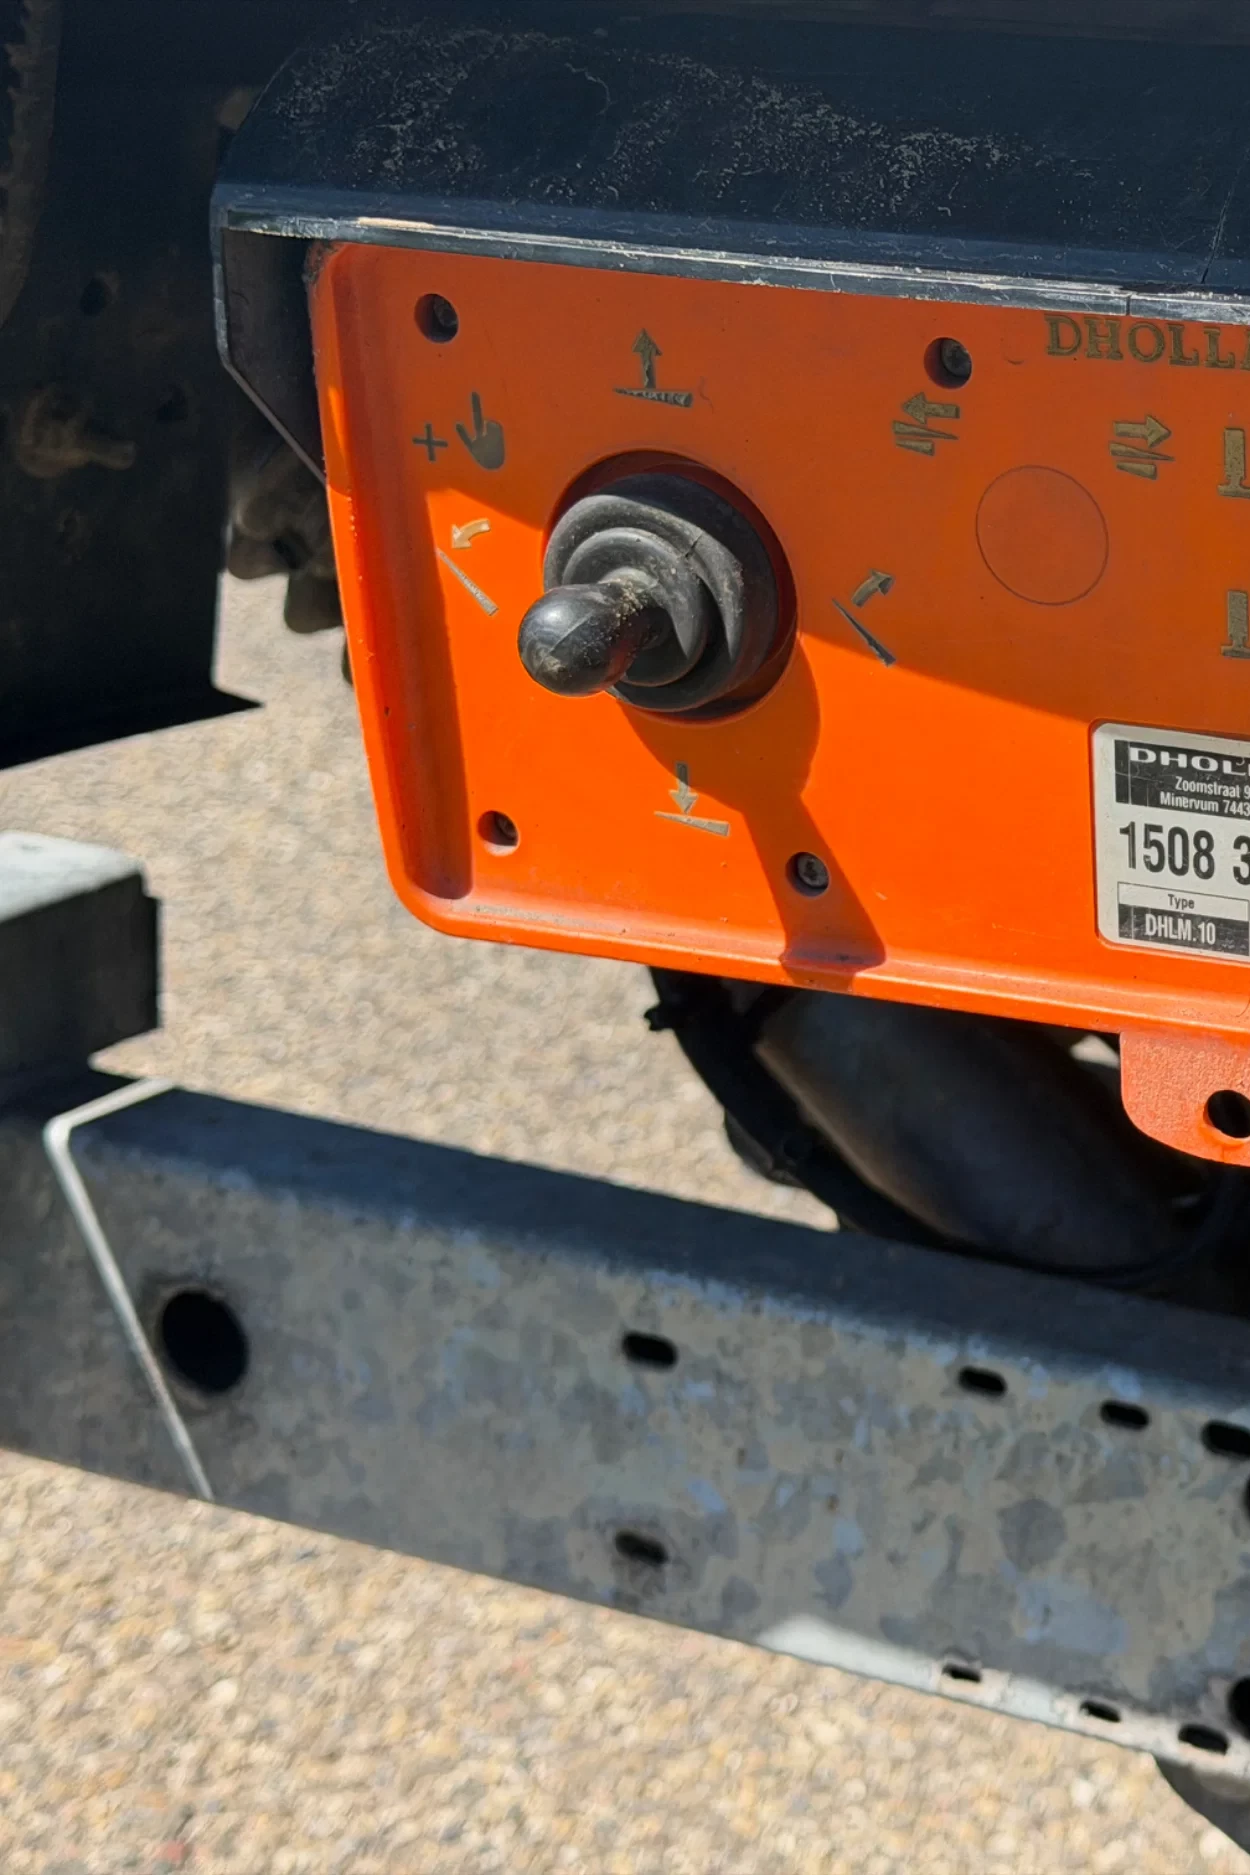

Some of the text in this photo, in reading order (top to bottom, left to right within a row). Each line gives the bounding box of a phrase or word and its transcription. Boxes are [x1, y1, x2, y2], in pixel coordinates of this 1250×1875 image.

[1175, 776, 1240, 799] Zoomstraat
[1244, 785, 1250, 800] 9
[1160, 791, 1219, 813] Minervum
[1223, 800, 1250, 817] 7443
[1119, 821, 1216, 881] 1508
[1168, 893, 1195, 910] Type
